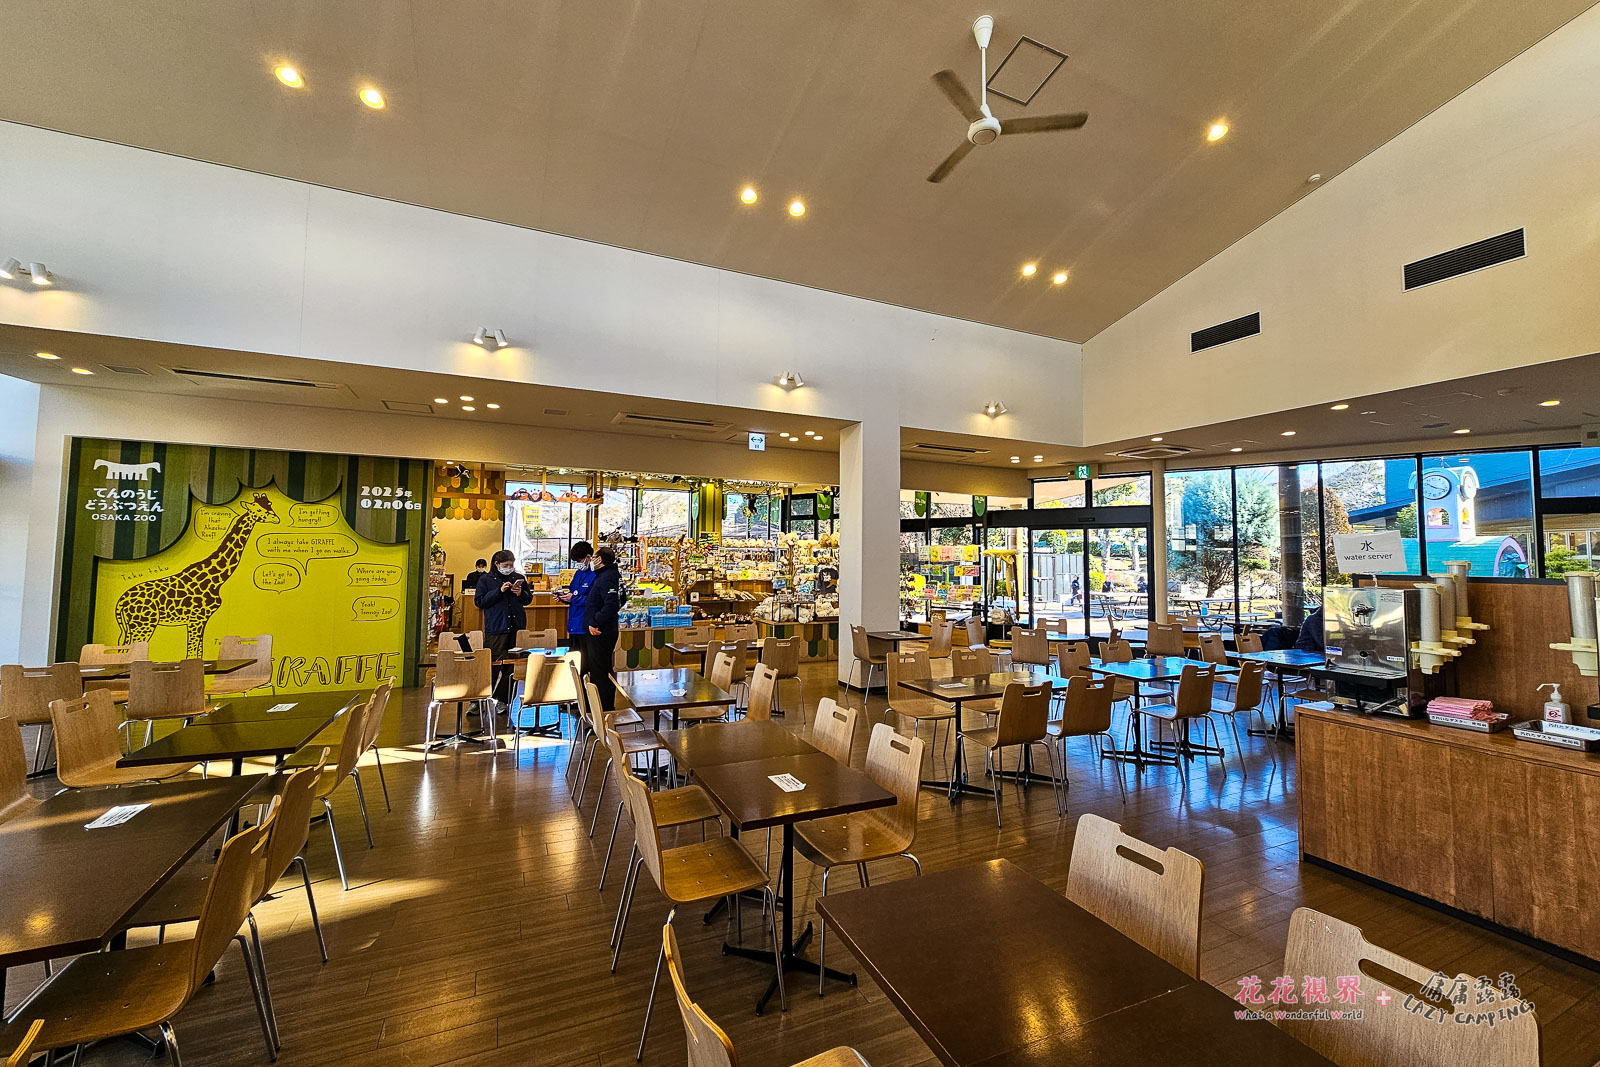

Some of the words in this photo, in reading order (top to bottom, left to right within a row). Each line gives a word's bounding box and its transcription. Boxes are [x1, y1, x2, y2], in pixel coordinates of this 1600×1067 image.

[93, 487, 159, 500] てんのうじ
[360, 485, 413, 498] 2025年
[85, 498, 165, 513] どうぶつえん
[360, 498, 422, 510] 02月06日
[91, 513, 131, 521] OSAKA
[133, 514, 157, 522] ZOO
[310, 538, 335, 546] GIRAFFE
[1360, 540, 1375, 551] 水
[1343, 553, 1366, 561] water
[271, 652, 400, 688] RAFFE
